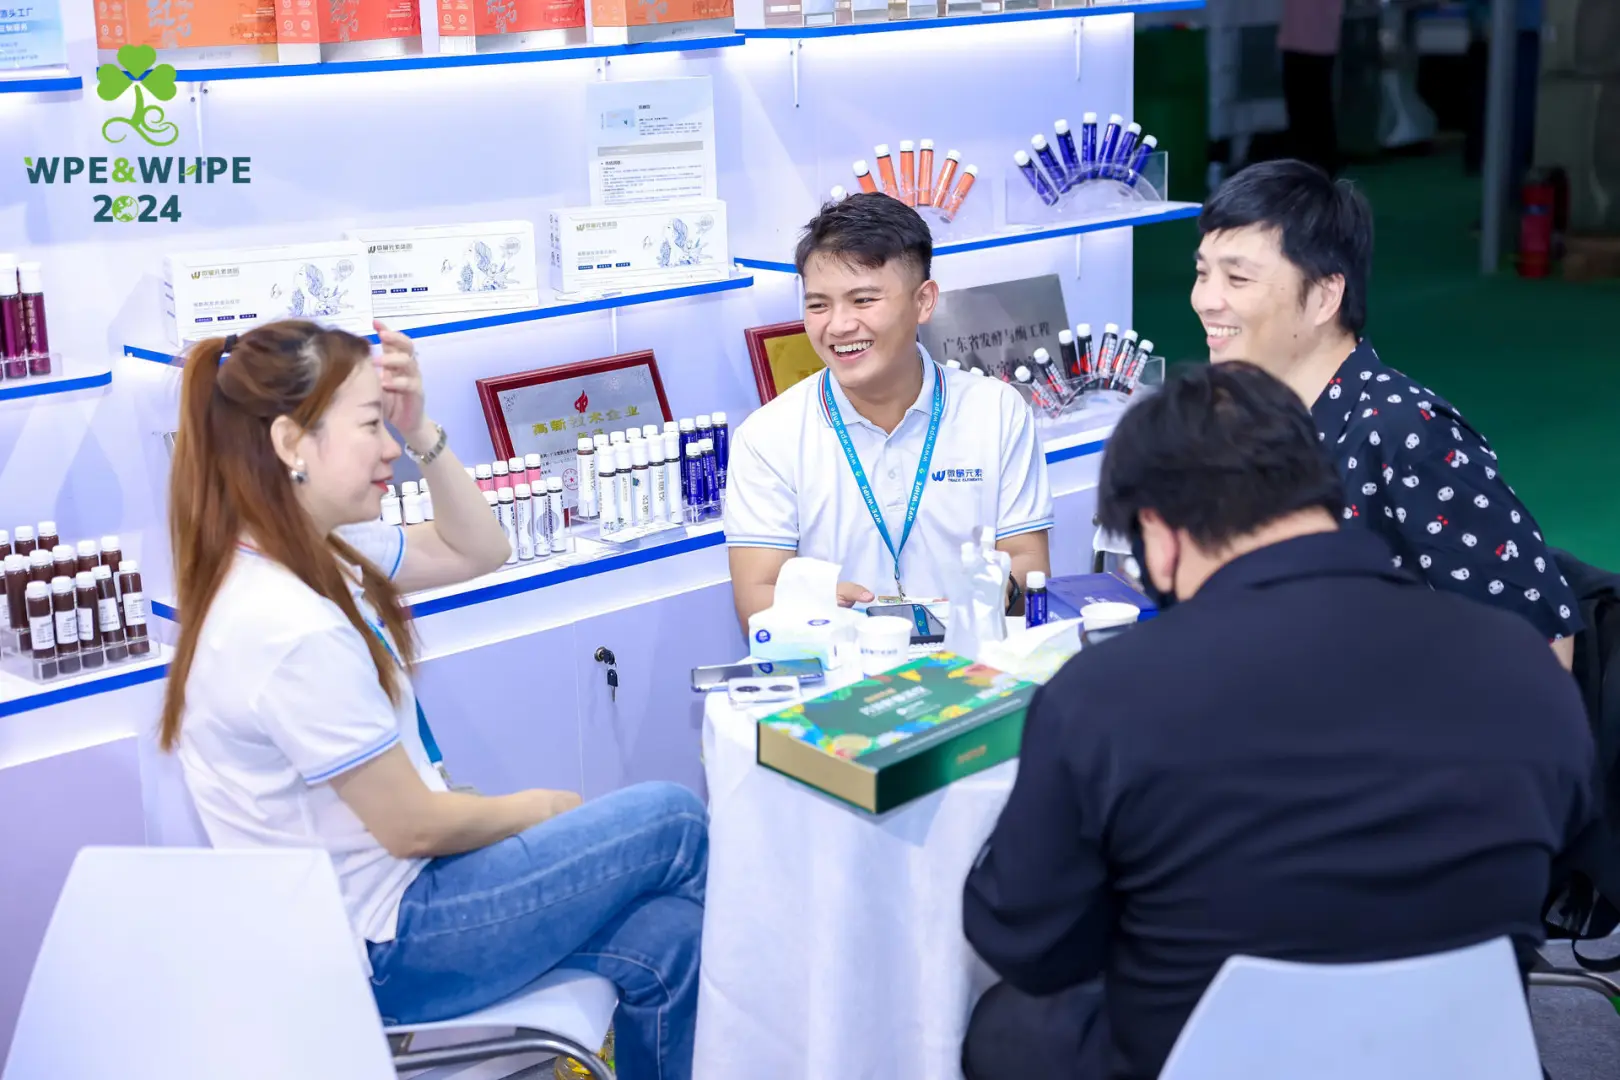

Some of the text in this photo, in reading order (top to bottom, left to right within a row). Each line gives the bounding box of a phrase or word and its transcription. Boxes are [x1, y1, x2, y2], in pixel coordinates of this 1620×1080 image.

[532, 404, 640, 436] 高新技术企业
